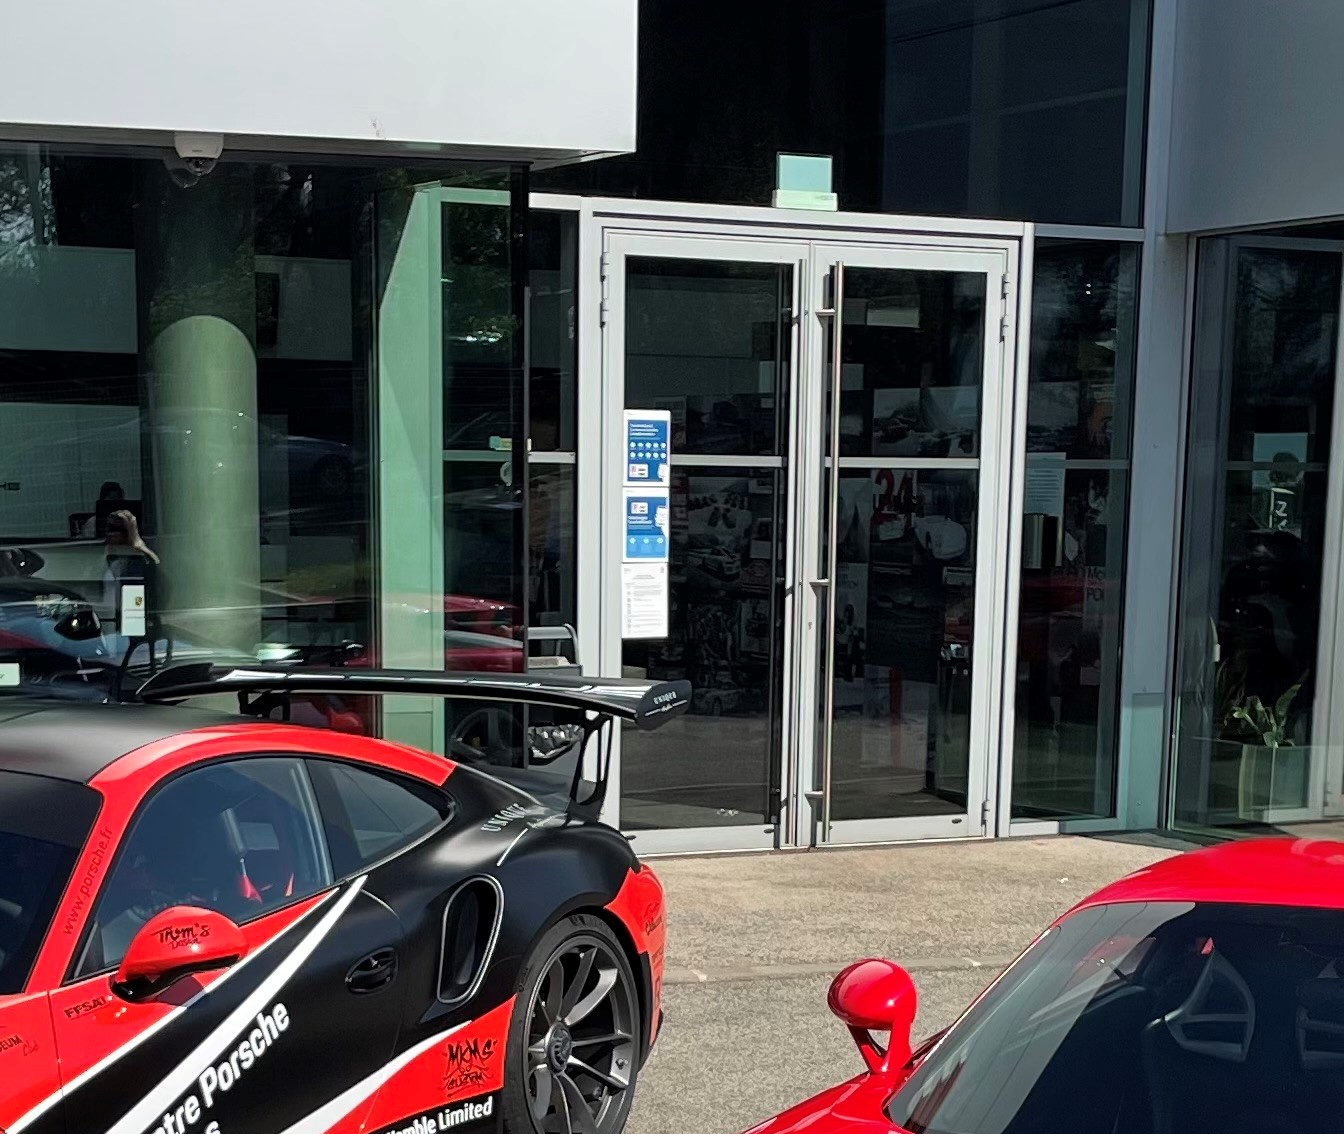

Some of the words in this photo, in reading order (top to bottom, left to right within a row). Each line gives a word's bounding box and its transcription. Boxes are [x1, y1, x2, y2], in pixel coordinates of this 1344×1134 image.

[63, 825, 113, 935] www.porsche.fr
[199, 1002, 290, 1109] Porsche
[437, 1095, 493, 1131] Limited
